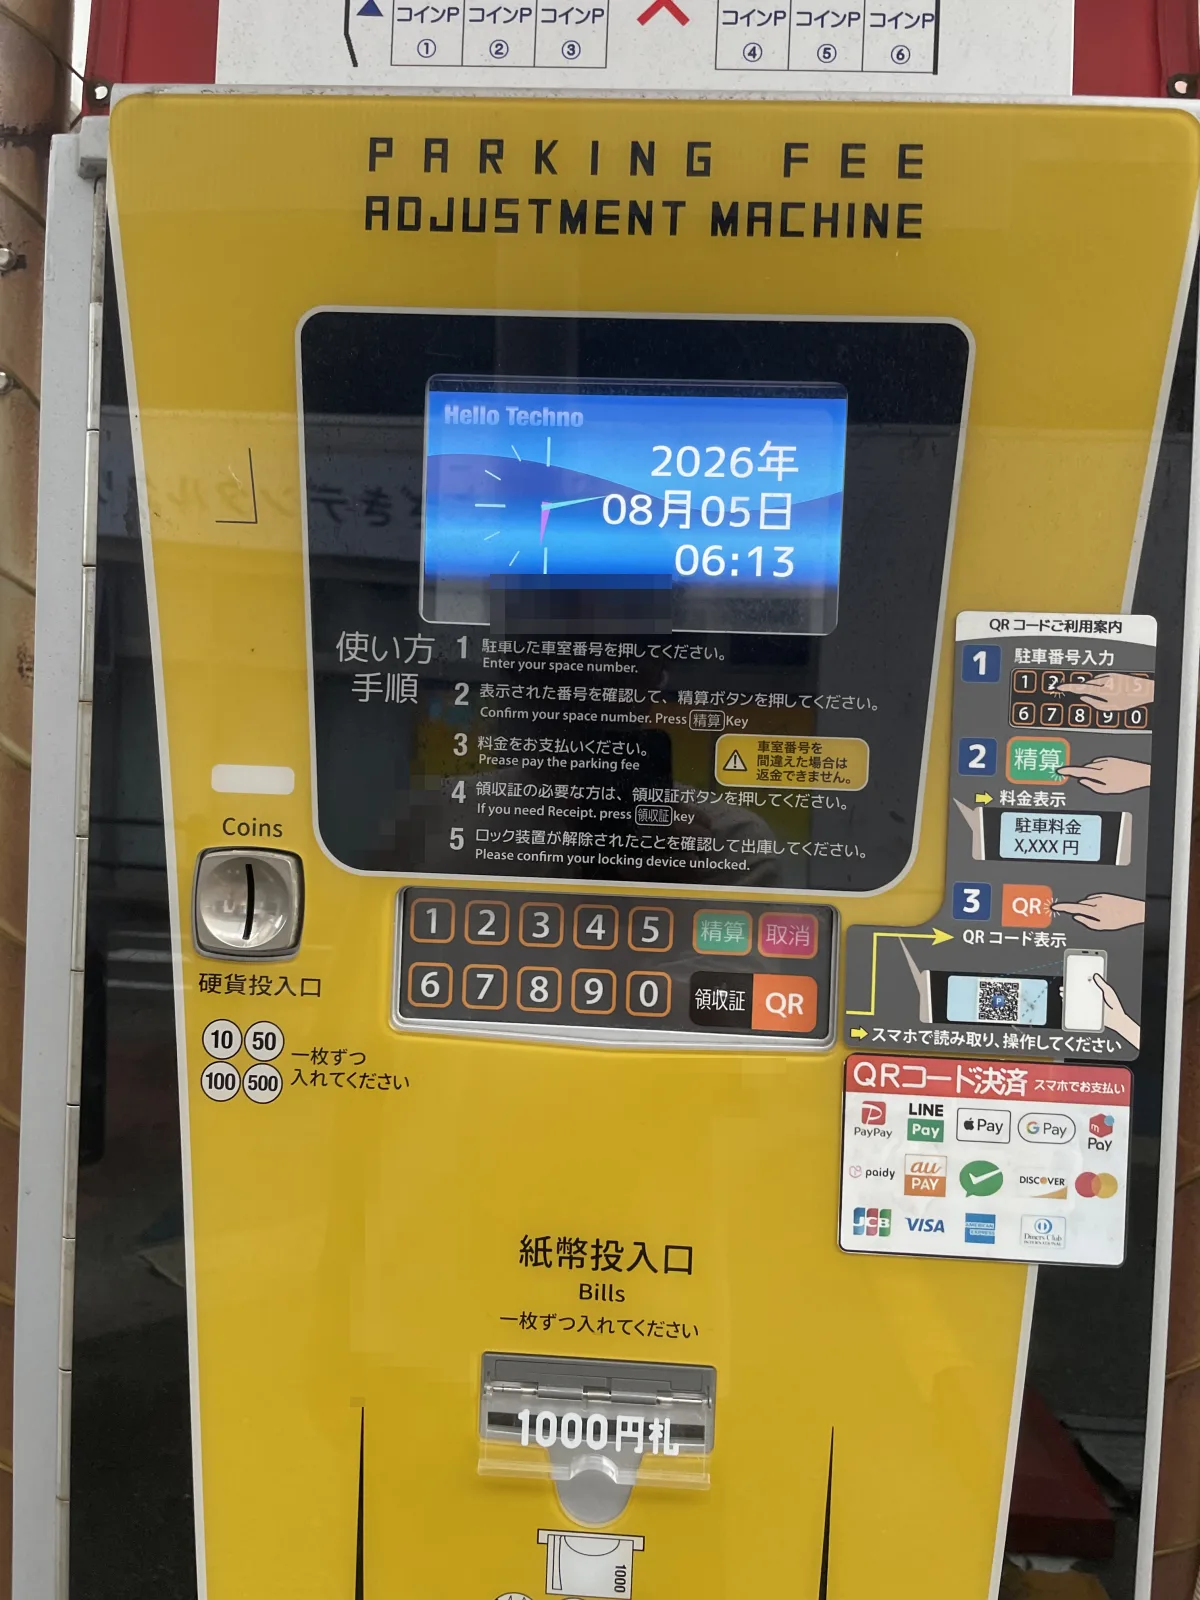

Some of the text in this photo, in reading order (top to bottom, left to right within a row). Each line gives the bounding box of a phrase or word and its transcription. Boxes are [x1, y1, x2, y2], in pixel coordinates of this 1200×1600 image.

[397, 6, 460, 24] コインP
[468, 6, 532, 24] コインP
[541, 7, 605, 25] コインP
[722, 9, 787, 27] コインP
[796, 10, 861, 28] コインP
[869, 11, 935, 29] コインP
[368, 137, 925, 180] PARKING FEE
[365, 195, 924, 240] ADJUSTMENT MACHINE
[444, 404, 584, 428] Hello Techno
[650, 441, 799, 481] 2026年
[601, 489, 793, 531] 08月05日
[674, 544, 795, 579] 06:13
[989, 619, 1122, 634] QR コードご利用案内
[336, 630, 436, 664] 使い方
[456, 635, 468, 659] 1
[481, 638, 726, 661] 駐車した車室番号を押してください。
[1014, 648, 1115, 667] 駐車番号入力
[482, 657, 638, 674] Enter your space number.
[972, 651, 988, 676] 1
[351, 672, 419, 704] 手順
[1021, 675, 1028, 688] 1
[453, 682, 470, 706] 2
[479, 682, 878, 711] 表示された番号を確認して、精算ボタンを押してください。
[480, 706, 749, 729] Confirm your space number. Press 精算 Key
[1018, 706, 1029, 720] 6
[1047, 708, 1057, 721] 7
[1074, 708, 1085, 722] 8
[1131, 710, 1142, 724] 0
[453, 732, 468, 756] 3
[477, 735, 647, 757] 料金をお支払いください。
[757, 740, 823, 754] 車室番号を
[478, 753, 640, 772] Prease pay the parking fee
[756, 754, 848, 770] 間違えた場合は
[968, 744, 987, 769] 2
[1014, 747, 1064, 772] 精算
[756, 769, 851, 785] 返金できません。
[451, 780, 467, 803] 4
[475, 780, 848, 811] 領収証の必要な方は、領収証ボタンを押してください。
[999, 789, 1066, 807] 料金表示
[477, 803, 695, 825] If you need Receipt. press 領収証 key
[222, 817, 283, 838] Coins
[1015, 817, 1082, 835] 駐車料金
[449, 827, 465, 850] 5
[475, 828, 866, 859] ロック装置が解除されたことを確認して出庫してください。
[475, 848, 750, 871] Please confirm your locking device unlocked.
[962, 888, 981, 913] 3
[1012, 897, 1042, 915] QR
[425, 907, 660, 943] 1 2 3 4 5
[700, 919, 811, 948] 精算 取消
[962, 929, 1067, 949] QR コード表示
[198, 973, 322, 998] 硬貨投入口
[420, 971, 659, 1007] 6 7 8 9 0
[694, 988, 805, 1016] 領収証 QR
[211, 1030, 277, 1052] 10 50
[872, 1026, 1123, 1054] スマホで読み取り、操作してください
[290, 1046, 367, 1066] 一枚ずつ
[205, 1072, 278, 1094] 100 500
[291, 1068, 410, 1090] 入れてください
[853, 1061, 1126, 1096] QRコード決済 スマホでお支払い
[909, 1102, 944, 1117] LINE
[853, 1127, 893, 1139] PayPay
[912, 1123, 940, 1138] Pay
[977, 1118, 1004, 1135] Pay
[1043, 1122, 1067, 1138] Pay
[1087, 1137, 1113, 1152] Pay
[865, 1168, 895, 1180] paidy
[910, 1160, 943, 1174] au
[911, 1177, 940, 1190] PAY
[1019, 1175, 1065, 1186] DISCOVER
[905, 1217, 945, 1233] VISA
[519, 1233, 693, 1276] 紙幣投入口
[578, 1283, 626, 1303] Bills
[499, 1311, 700, 1340] 一枚ずつ入れてください
[517, 1408, 680, 1456] 1000円札
[613, 1564, 627, 1593] 1000
